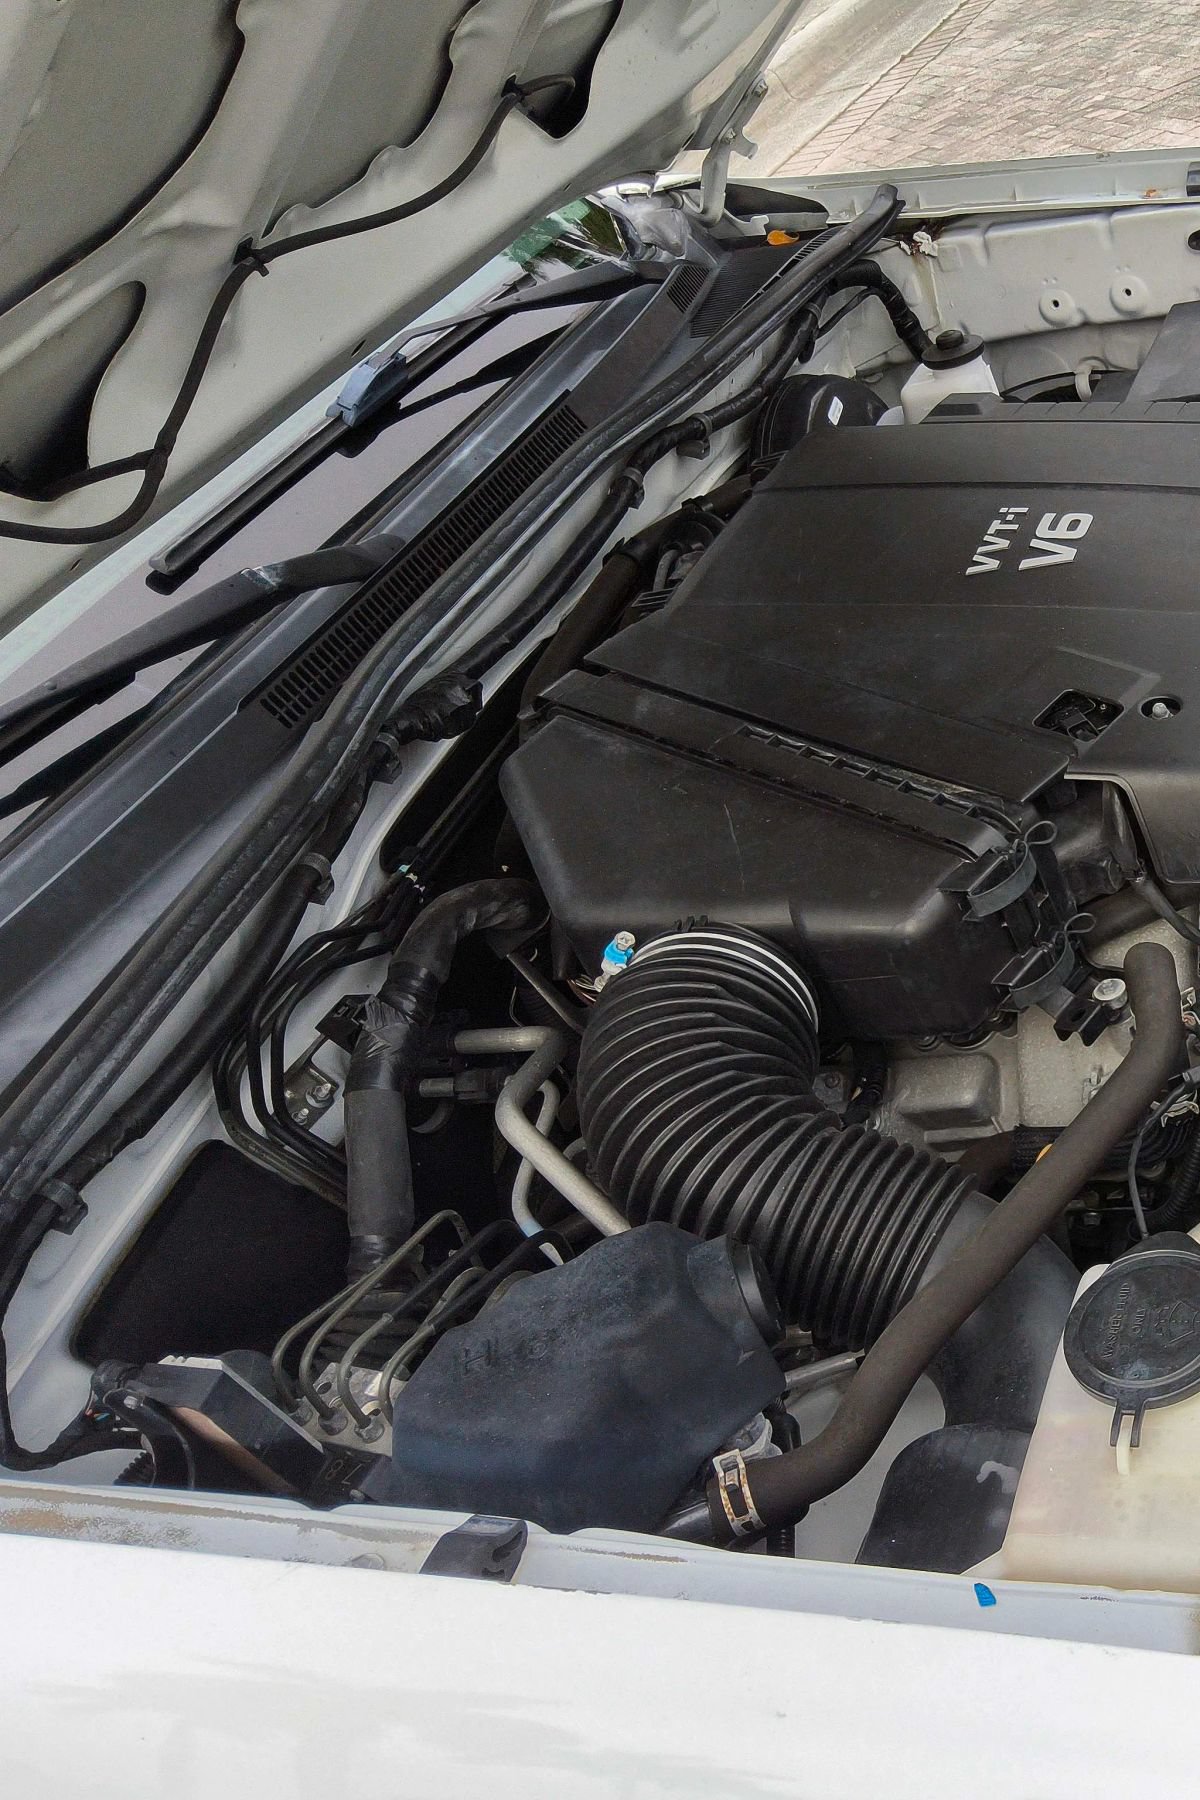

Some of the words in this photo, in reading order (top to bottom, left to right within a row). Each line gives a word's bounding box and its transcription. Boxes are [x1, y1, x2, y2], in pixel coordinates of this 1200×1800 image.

[965, 507, 1030, 576] VVT-i
[1018, 512, 1094, 571] V6
[1102, 1313, 1122, 1358] WASHER
[1115, 1282, 1130, 1311] FLUID
[1131, 1308, 1146, 1334] ONLY
